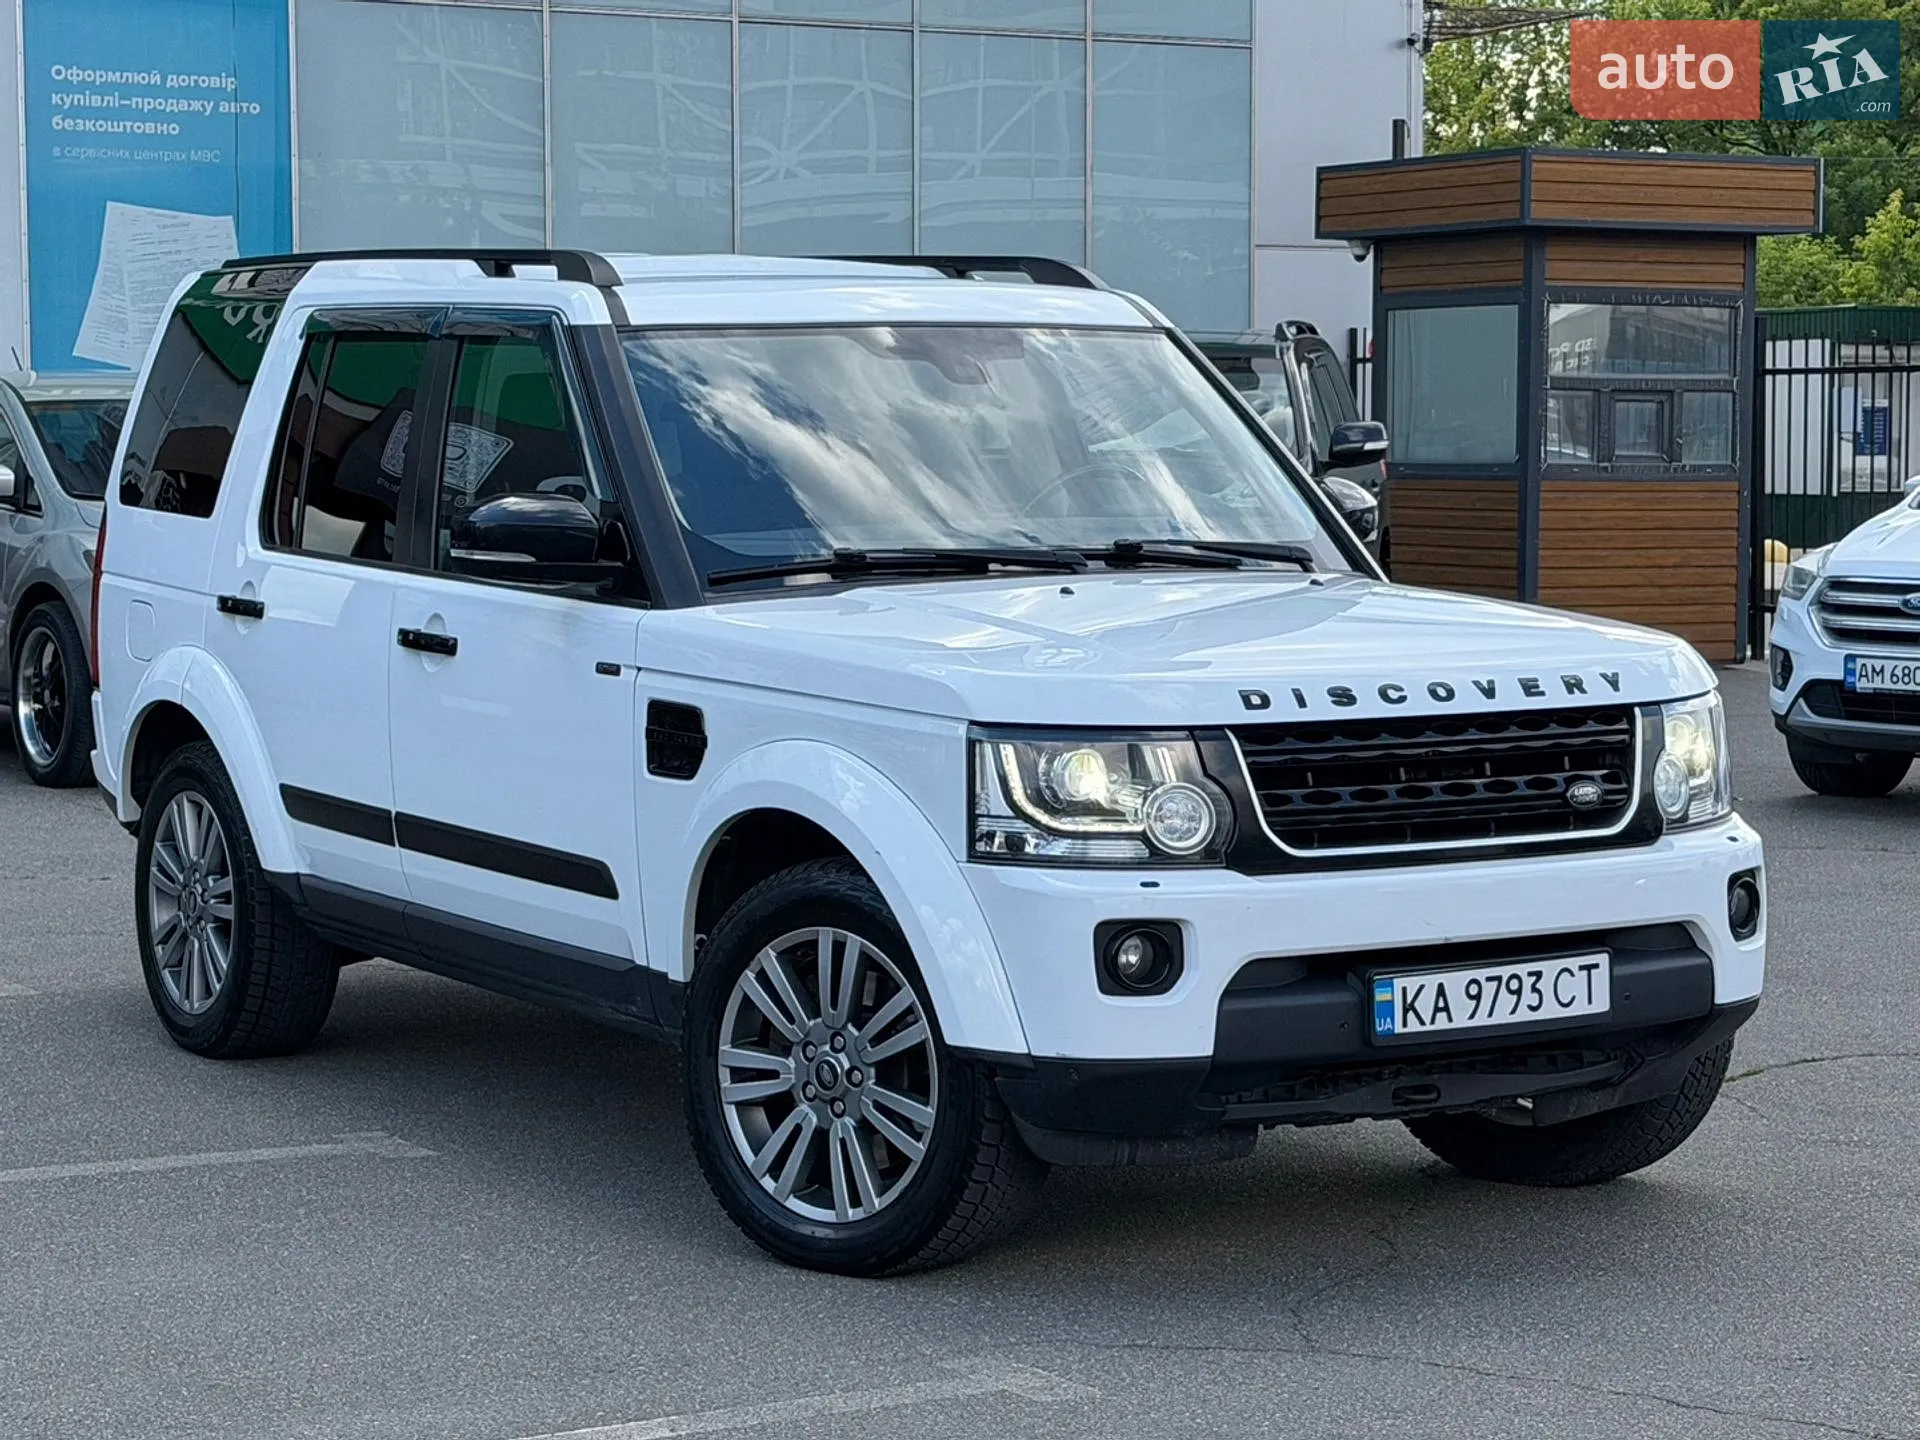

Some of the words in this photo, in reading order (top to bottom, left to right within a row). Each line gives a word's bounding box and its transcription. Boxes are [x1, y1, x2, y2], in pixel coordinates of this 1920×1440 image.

[51, 65, 161, 86] Оформлюй
[166, 72, 237, 92] договір
[219, 100, 261, 114] авто
[51, 114, 180, 135] безкоштовно
[134, 150, 186, 163] центрах
[190, 150, 221, 163] МВС
[1858, 663, 1885, 684] AM
[1238, 671, 1621, 711] DISCOVERY
[1401, 982, 1454, 1029] KA
[1464, 970, 1544, 1021] 9793
[1553, 963, 1600, 1009] CT
[1376, 1017, 1393, 1031] UA
